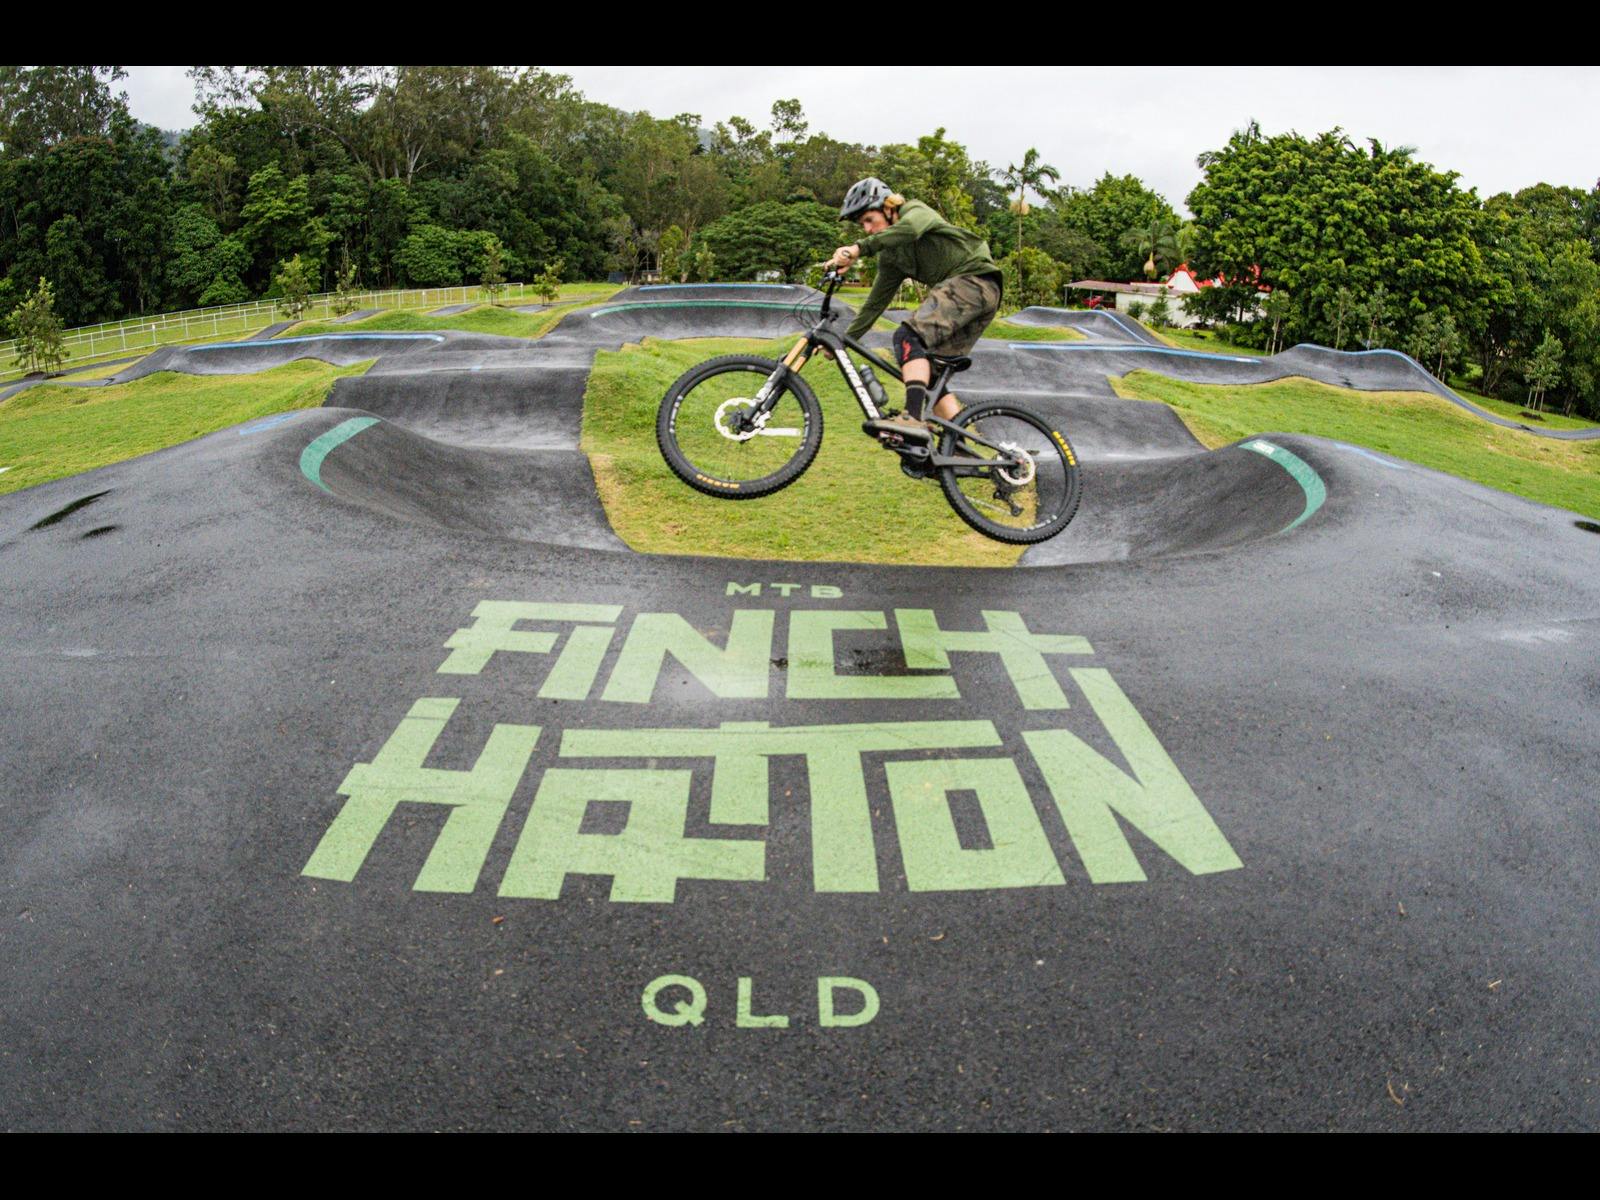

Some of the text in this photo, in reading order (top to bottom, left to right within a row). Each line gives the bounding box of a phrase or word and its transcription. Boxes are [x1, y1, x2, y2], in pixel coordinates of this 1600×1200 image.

[725, 581, 844, 599] MTB
[302, 667, 1245, 905] HATTON
[641, 973, 881, 1029] QLD
